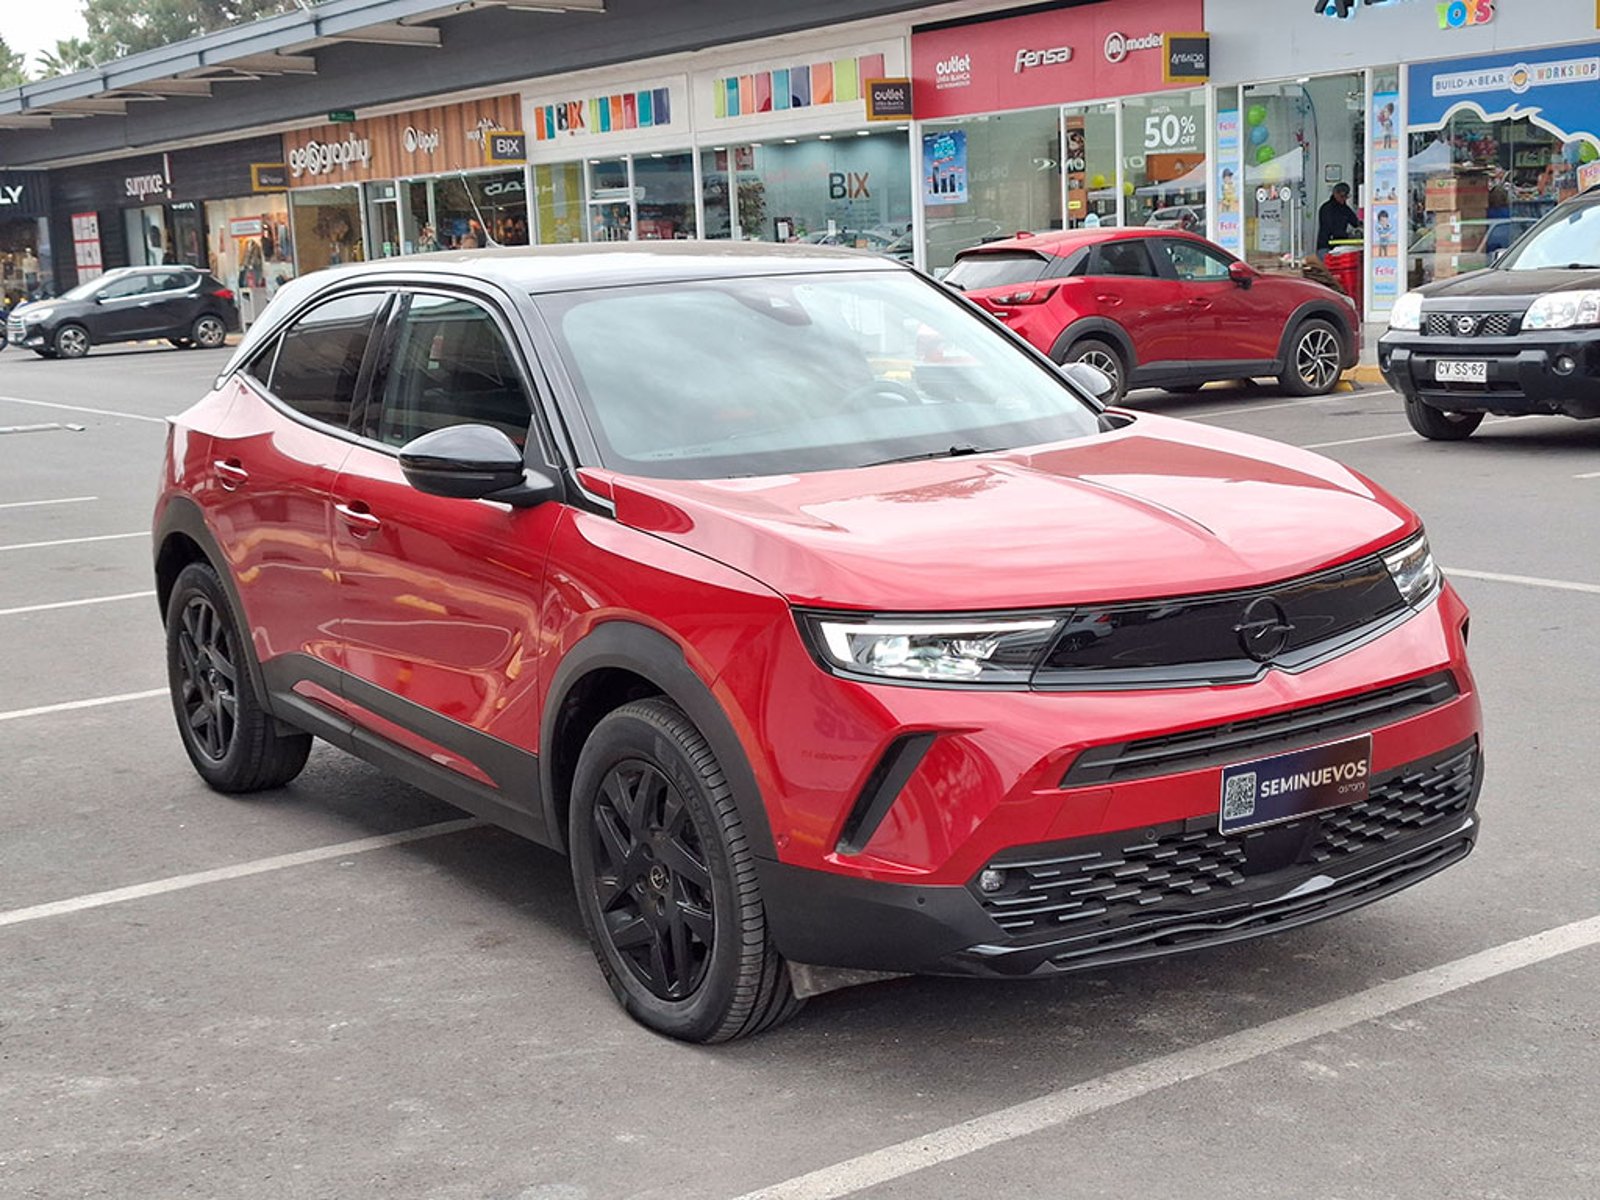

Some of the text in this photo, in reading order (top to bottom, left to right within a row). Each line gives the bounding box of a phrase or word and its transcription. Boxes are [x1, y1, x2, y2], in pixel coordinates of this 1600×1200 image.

[1435, 0, 1494, 29] TOYS
[936, 53, 971, 75] outlet
[1014, 46, 1072, 73] fensa
[1537, 63, 1597, 80] WORKSHOP
[874, 88, 904, 101] outlet
[557, 100, 585, 131] BIX
[1144, 113, 1196, 149] 50%
[1180, 135, 1196, 145] OFF
[496, 138, 520, 153] BIX
[829, 172, 870, 200] BIX
[1260, 759, 1368, 798] SEMINUEVOS
